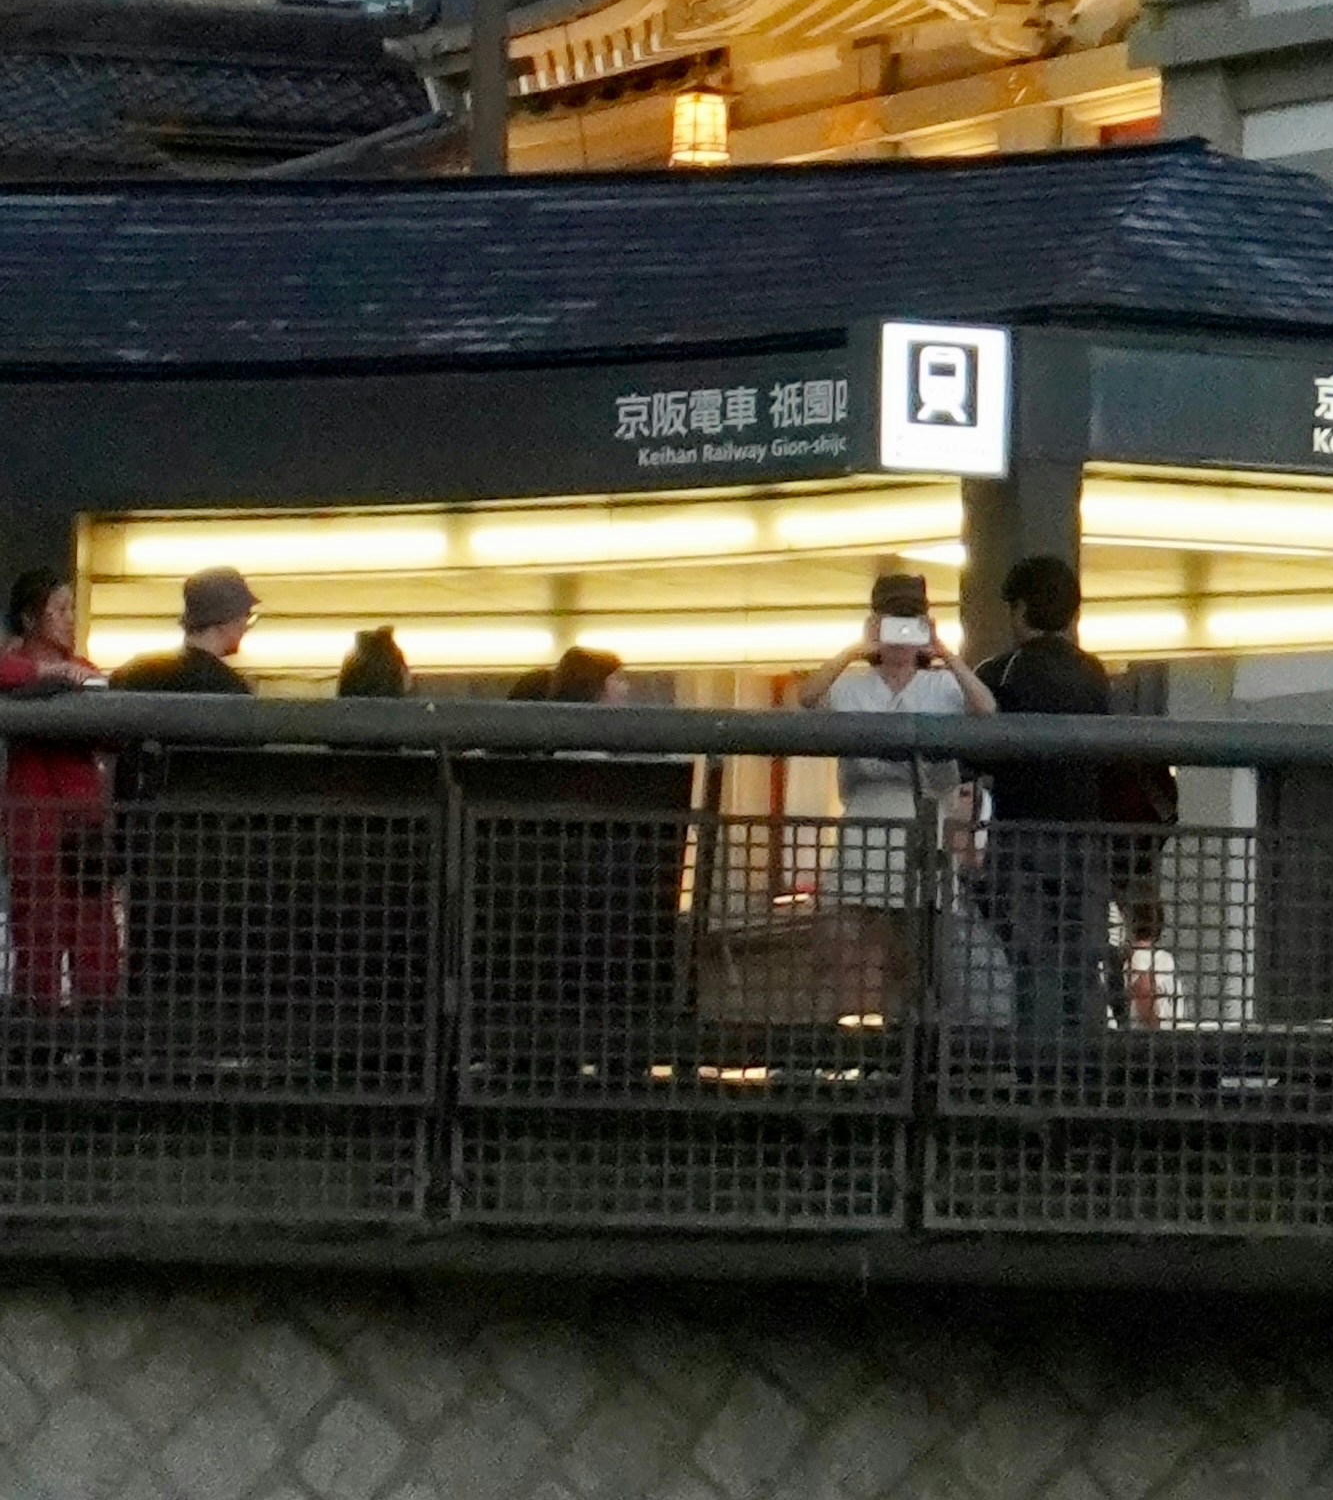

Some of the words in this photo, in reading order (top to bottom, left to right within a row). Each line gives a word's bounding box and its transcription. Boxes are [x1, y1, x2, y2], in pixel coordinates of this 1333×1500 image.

[613, 386, 758, 440] 京阪電車
[638, 445, 697, 466] Keihan
[702, 443, 766, 463] Railway
